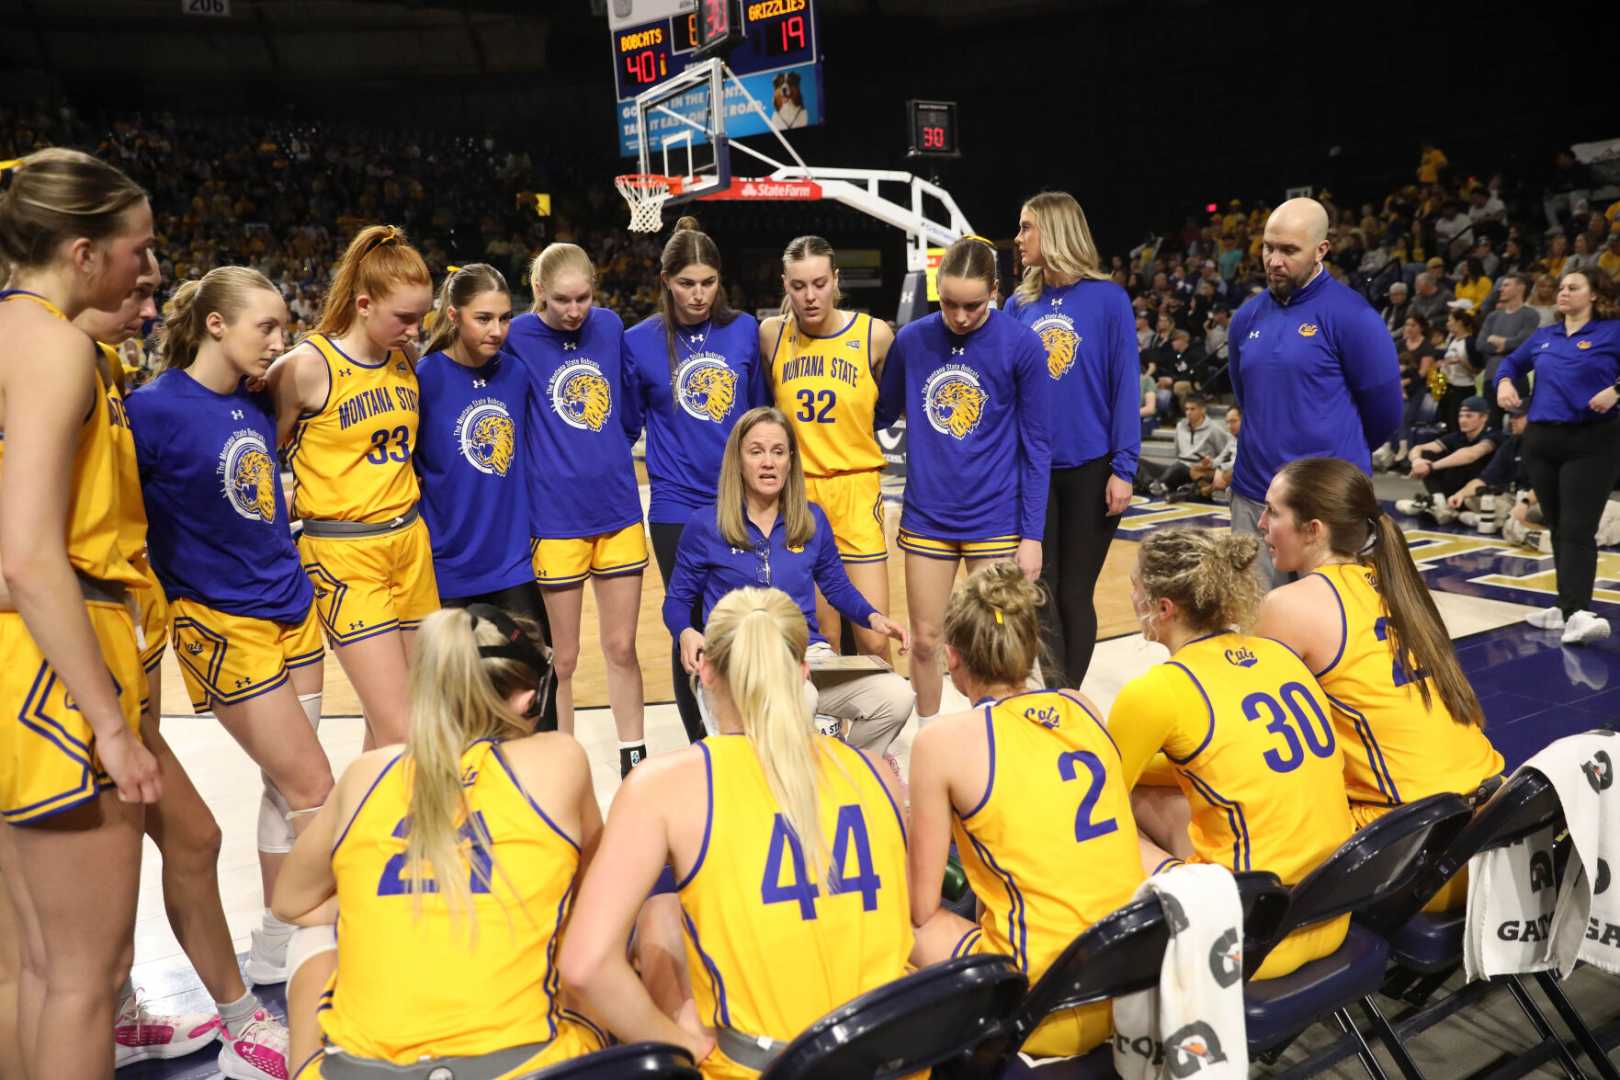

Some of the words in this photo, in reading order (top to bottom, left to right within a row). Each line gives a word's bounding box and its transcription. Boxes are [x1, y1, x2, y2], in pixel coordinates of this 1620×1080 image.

[620, 27, 662, 52] BOBCATS
[782, 15, 805, 51] 19
[626, 50, 657, 83] 40
[923, 127, 945, 147] 30
[782, 355, 824, 385] MONTANA
[831, 357, 858, 388] STATE
[338, 386, 395, 431] MONTANA
[796, 389, 836, 424] 32
[367, 424, 410, 465] 33
[1241, 681, 1335, 773] 30
[1057, 750, 1118, 843] 2
[761, 804, 881, 920] 44
